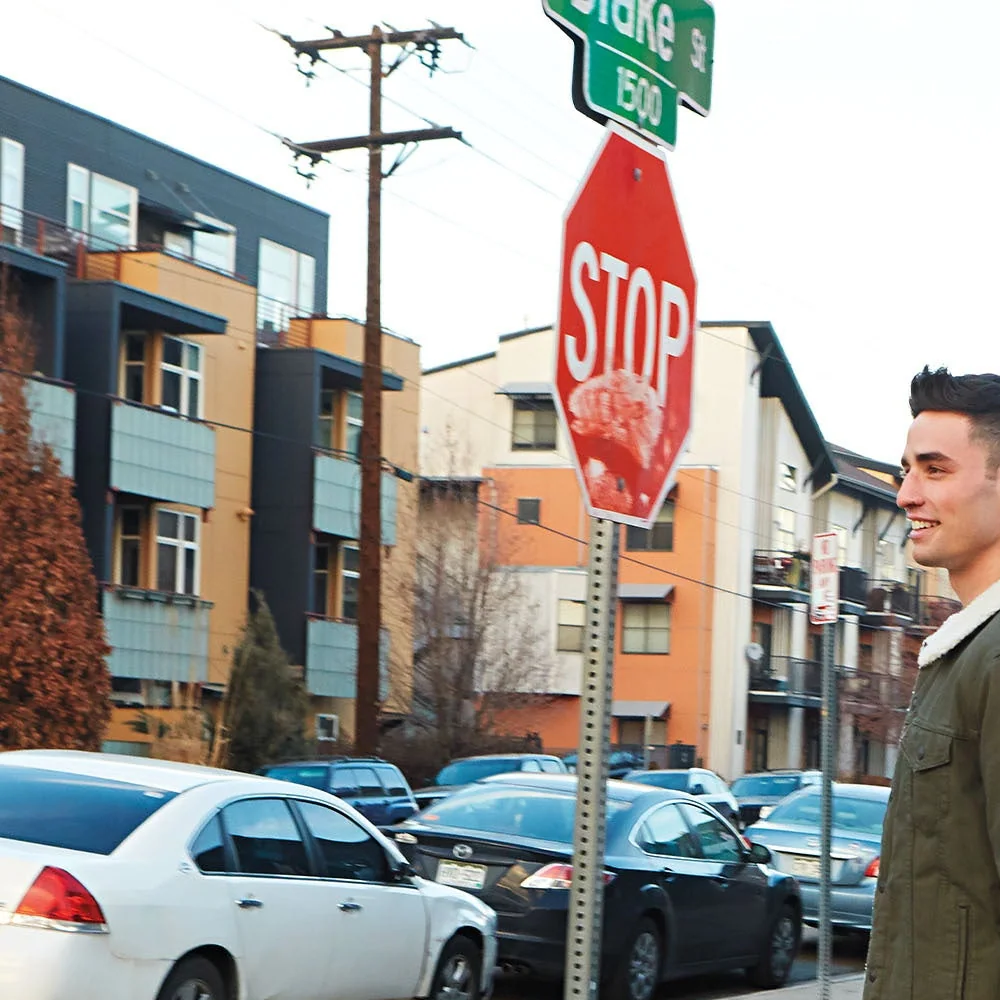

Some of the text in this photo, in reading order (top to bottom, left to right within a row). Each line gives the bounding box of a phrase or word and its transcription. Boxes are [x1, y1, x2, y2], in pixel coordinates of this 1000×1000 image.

[571, 0, 675, 61] ake
[617, 66, 662, 126] 1500
[565, 241, 690, 408] STOP
